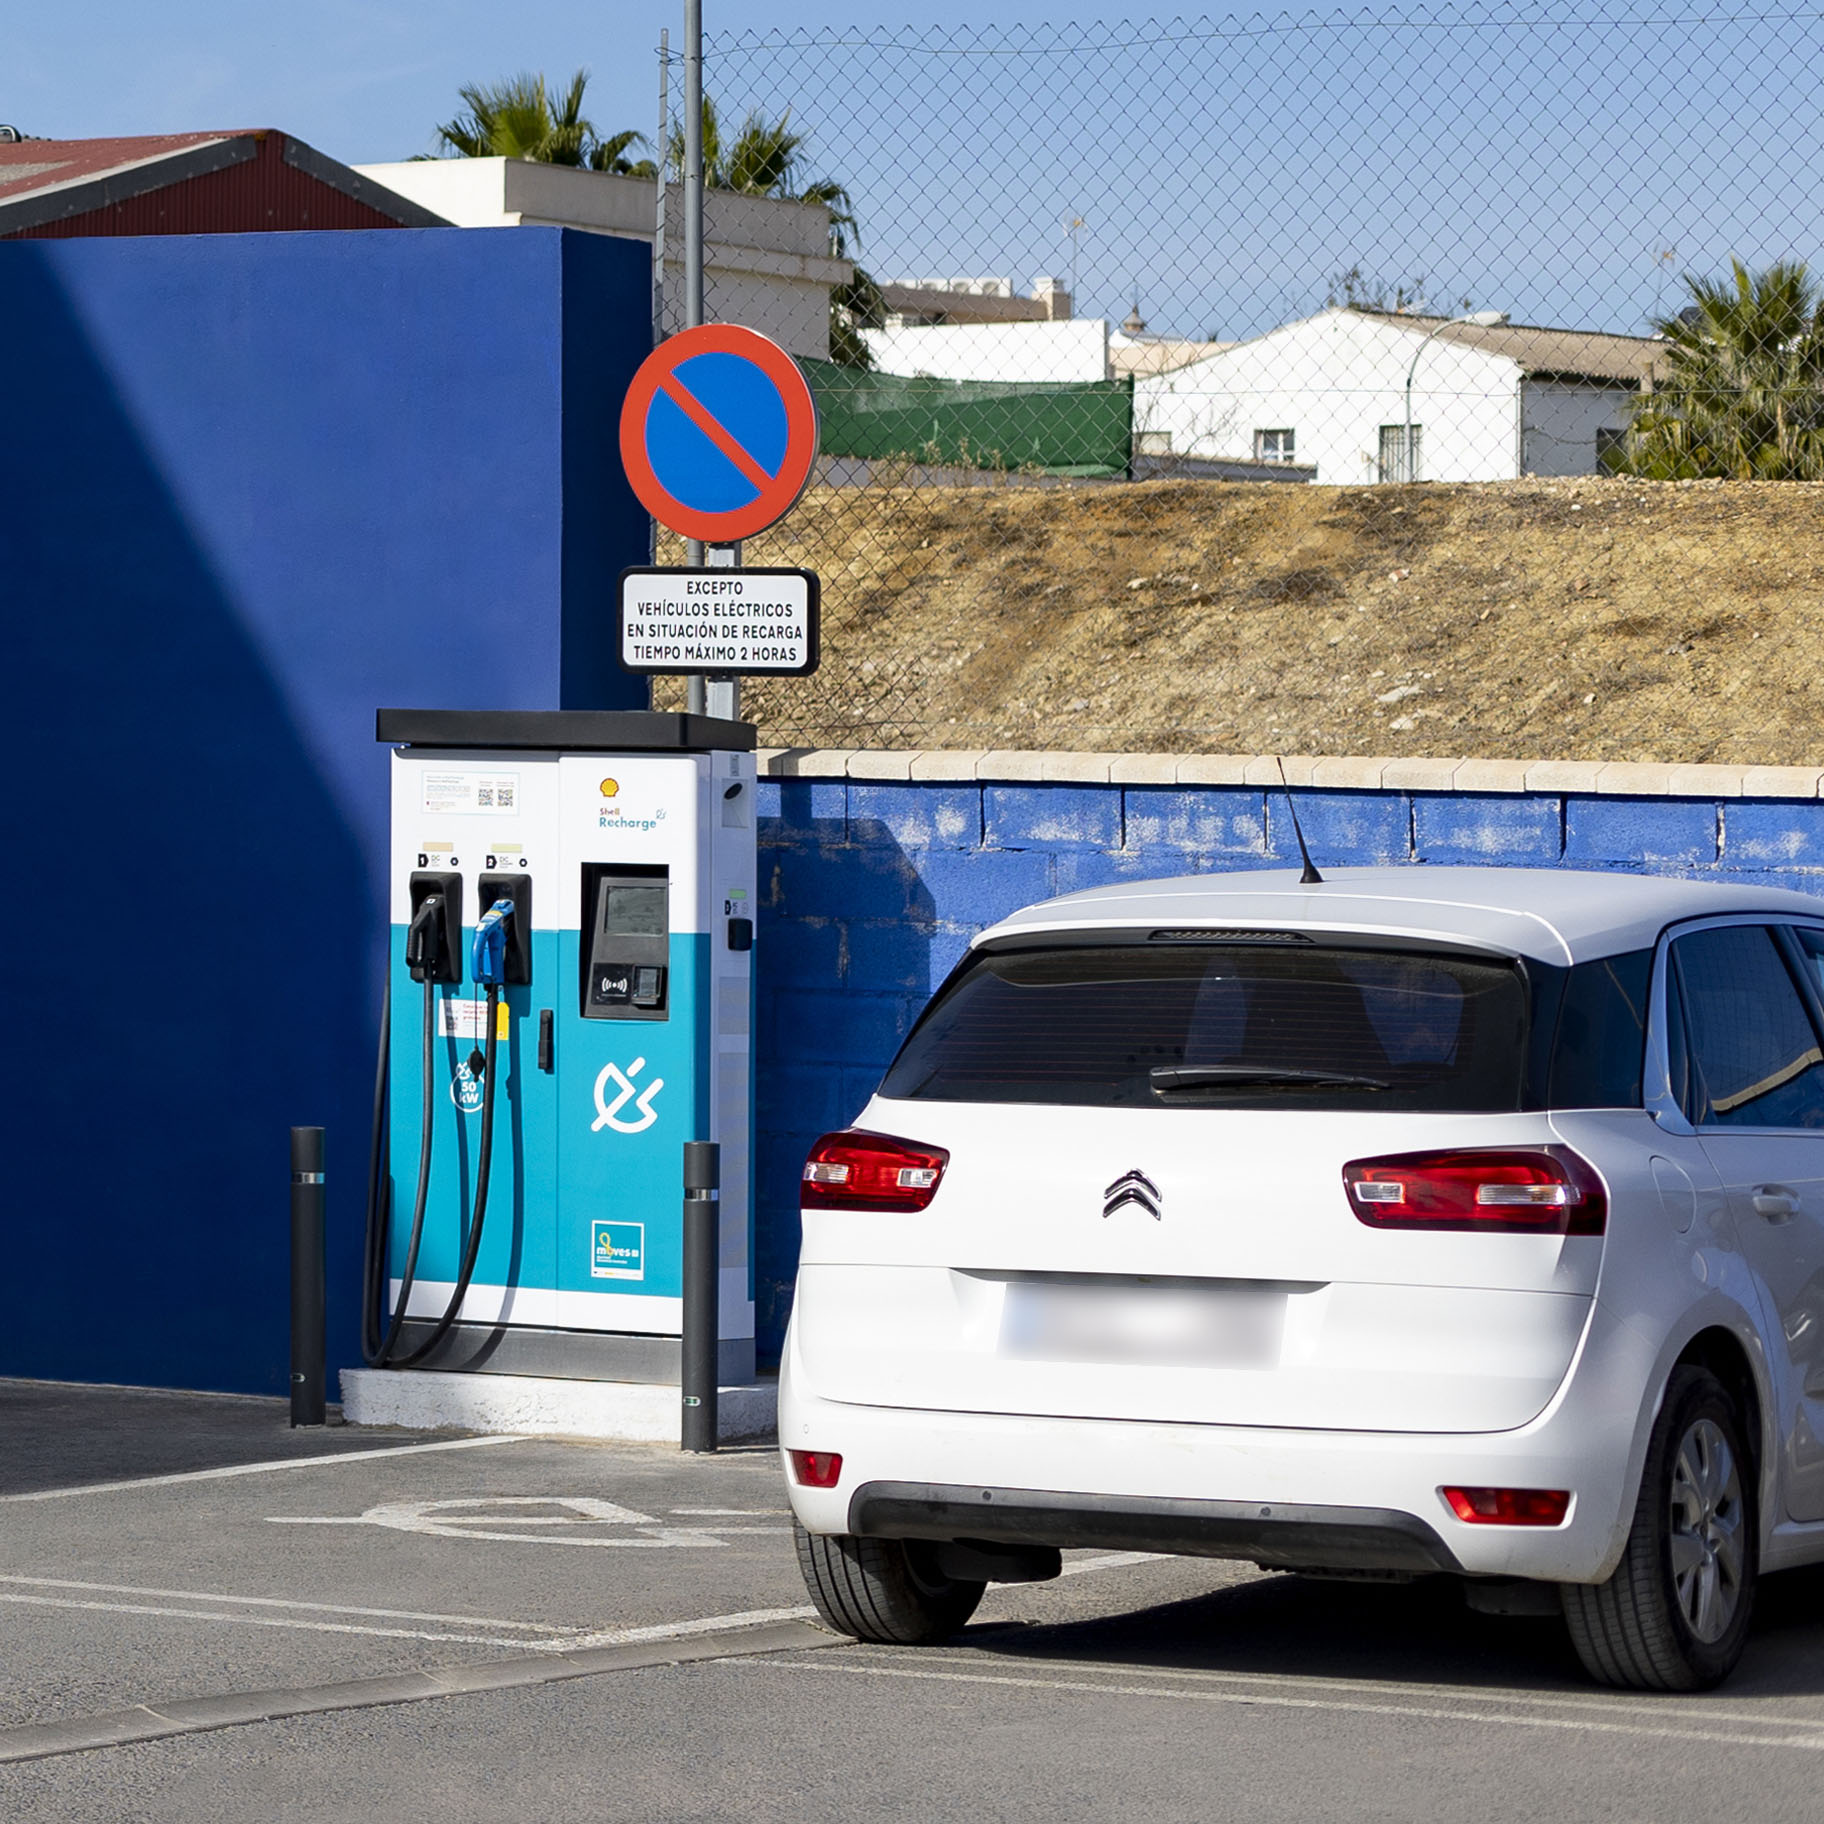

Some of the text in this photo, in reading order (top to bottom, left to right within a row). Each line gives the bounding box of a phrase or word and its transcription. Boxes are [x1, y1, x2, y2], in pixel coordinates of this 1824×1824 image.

[686, 581, 743, 595] EXCEPTO
[637, 599, 793, 617] VEHÍCULOS ELÉCTRICOS
[627, 621, 803, 639] EN SITUACIÓN DE RECARGA
[634, 642, 797, 661] TIEMPO MÁXIMO 2 HORAS
[599, 807, 620, 816] Shell
[599, 816, 657, 831] Recharge
[461, 1081, 477, 1092] 50
[458, 1092, 479, 1104] kW
